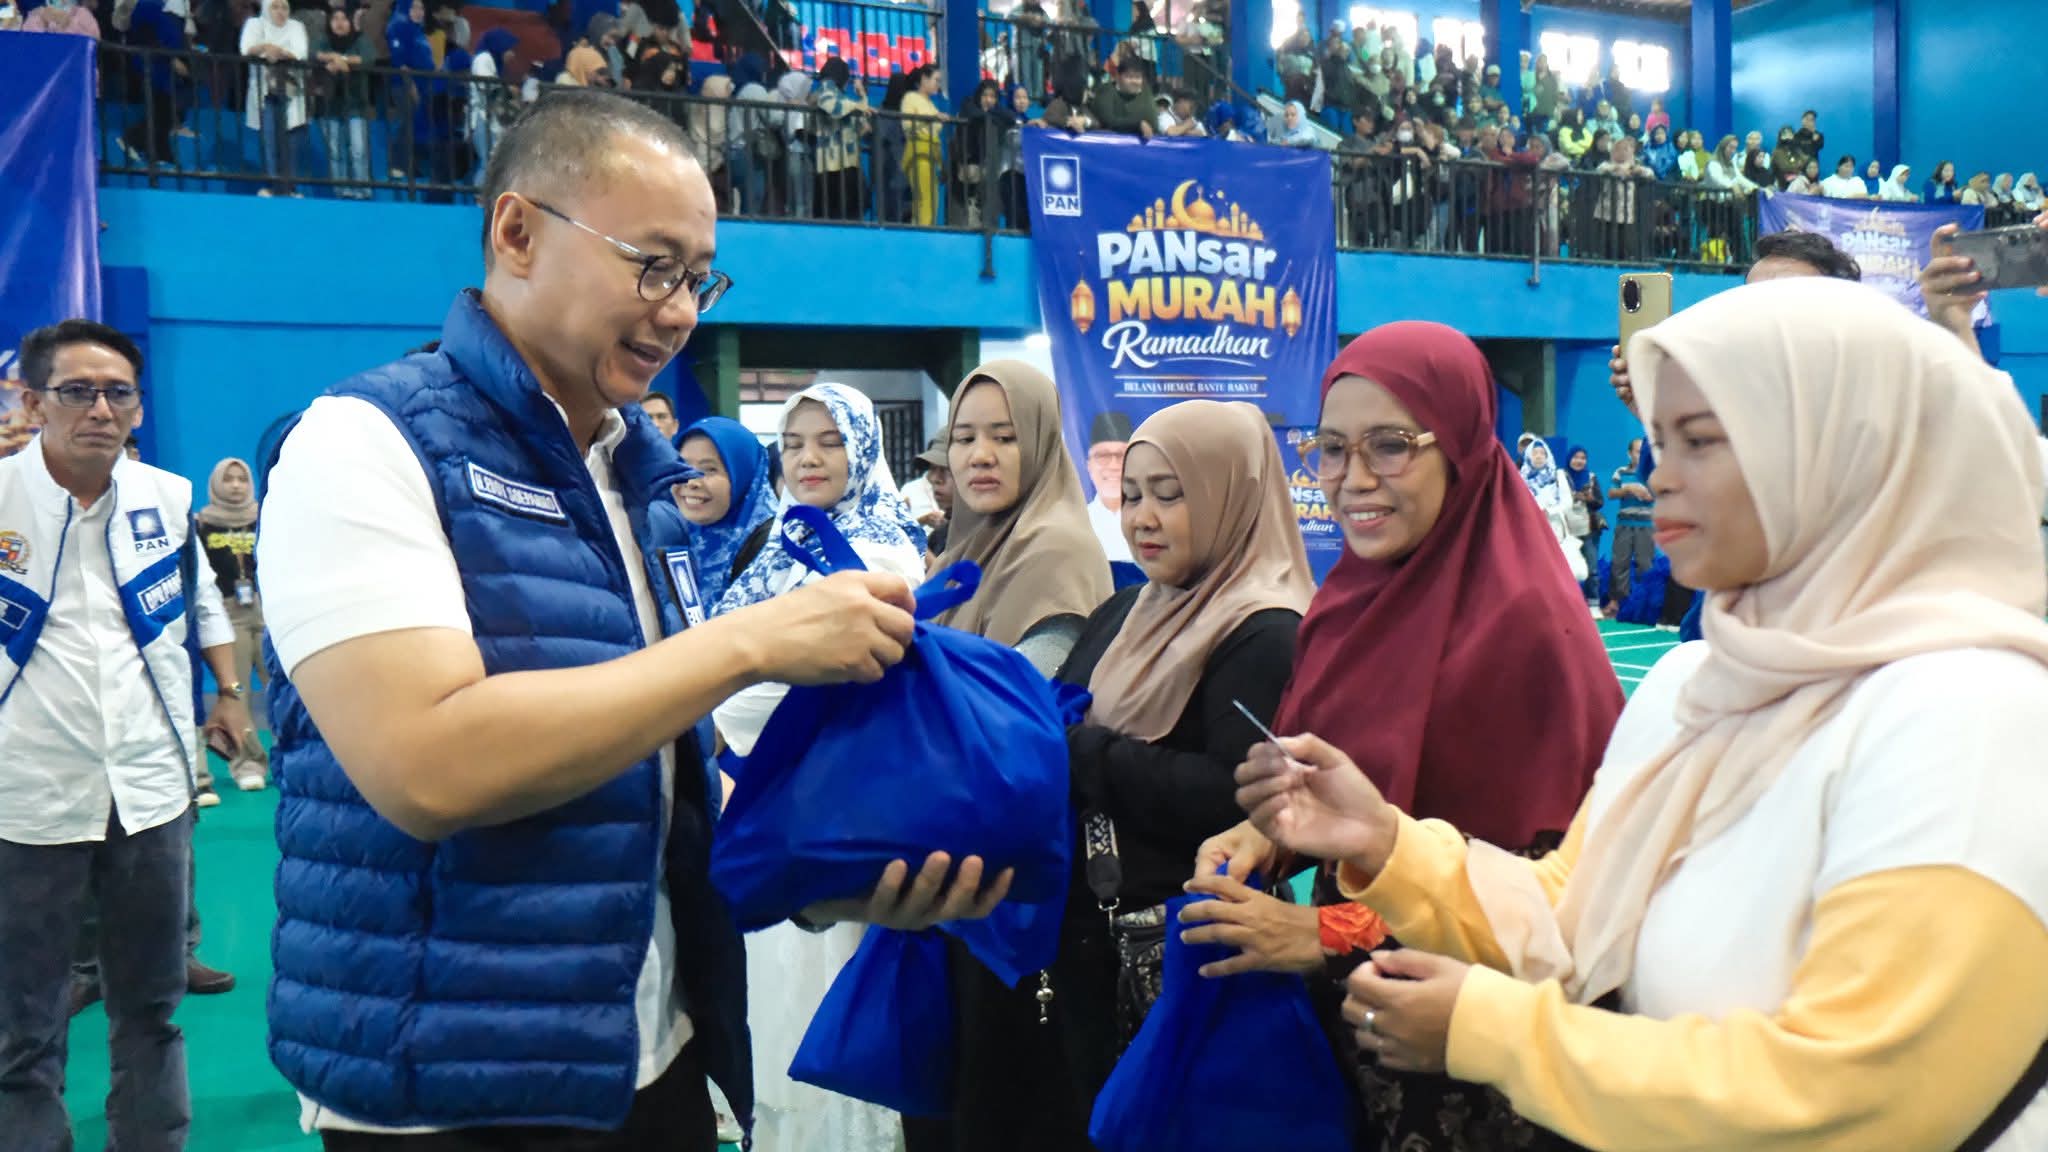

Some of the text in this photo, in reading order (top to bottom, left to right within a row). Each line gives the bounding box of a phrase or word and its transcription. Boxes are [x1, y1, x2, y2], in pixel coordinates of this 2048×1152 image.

[1045, 197, 1079, 210] PAN
[1097, 230, 1277, 280] PANsar
[1108, 278, 1276, 329] MURAH
[1102, 320, 1272, 369] Ramadhan
[1124, 382, 1162, 393] BELANJA
[1198, 382, 1225, 392] BANTU
[1228, 382, 1258, 392] RAKYAT
[135, 538, 169, 552] PAN
